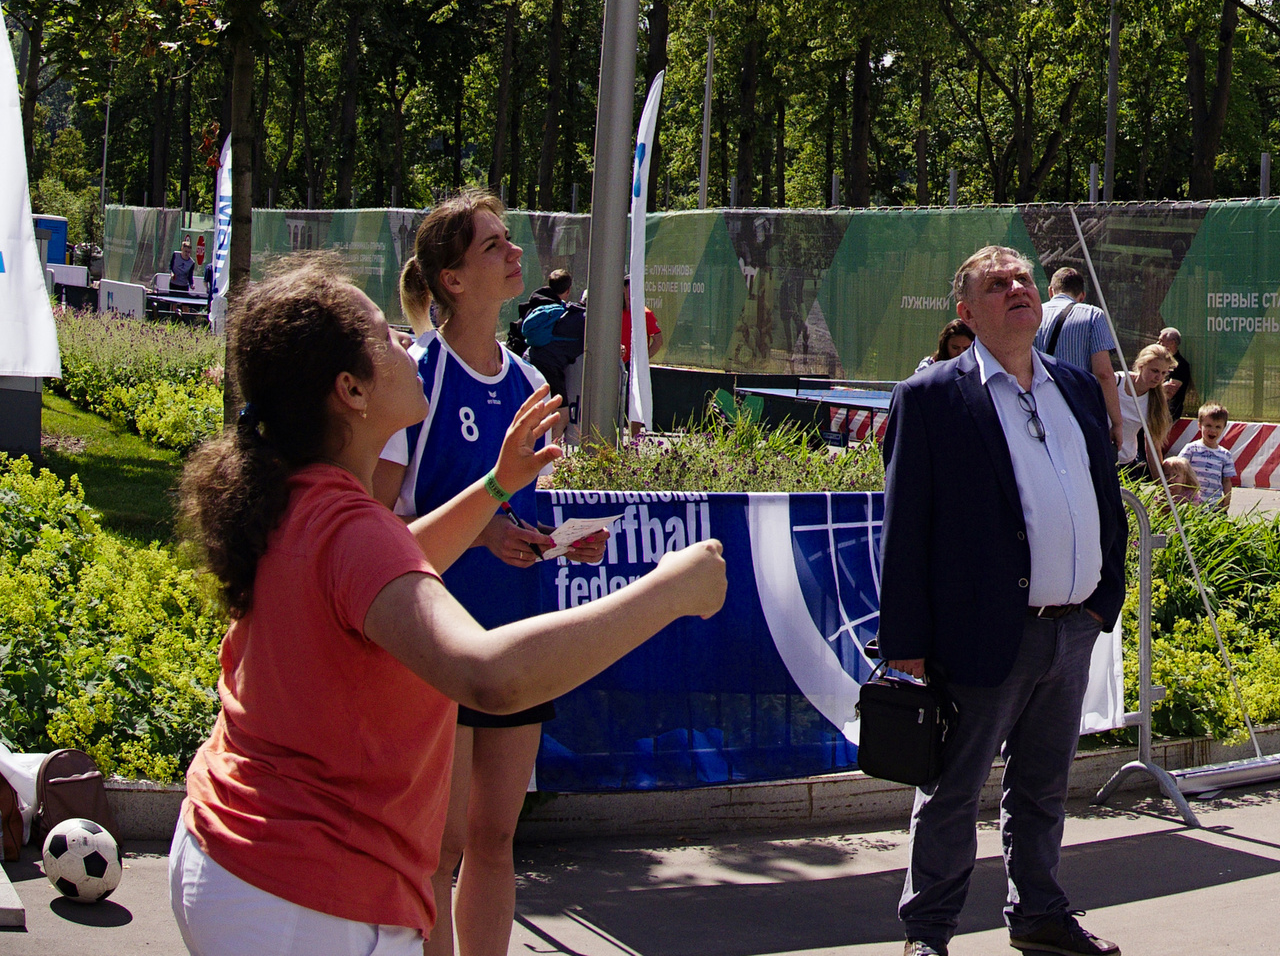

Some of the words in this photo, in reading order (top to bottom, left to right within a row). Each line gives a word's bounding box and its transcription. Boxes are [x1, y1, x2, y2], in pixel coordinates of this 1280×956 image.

[657, 281, 678, 292] БОЛЕЕ
[680, 281, 692, 293] 100
[692, 282, 705, 294] 000
[901, 295, 950, 311] ЛУЖНИКИ
[1207, 293, 1259, 308] ПЕРВЫЕ
[459, 406, 479, 442] 8
